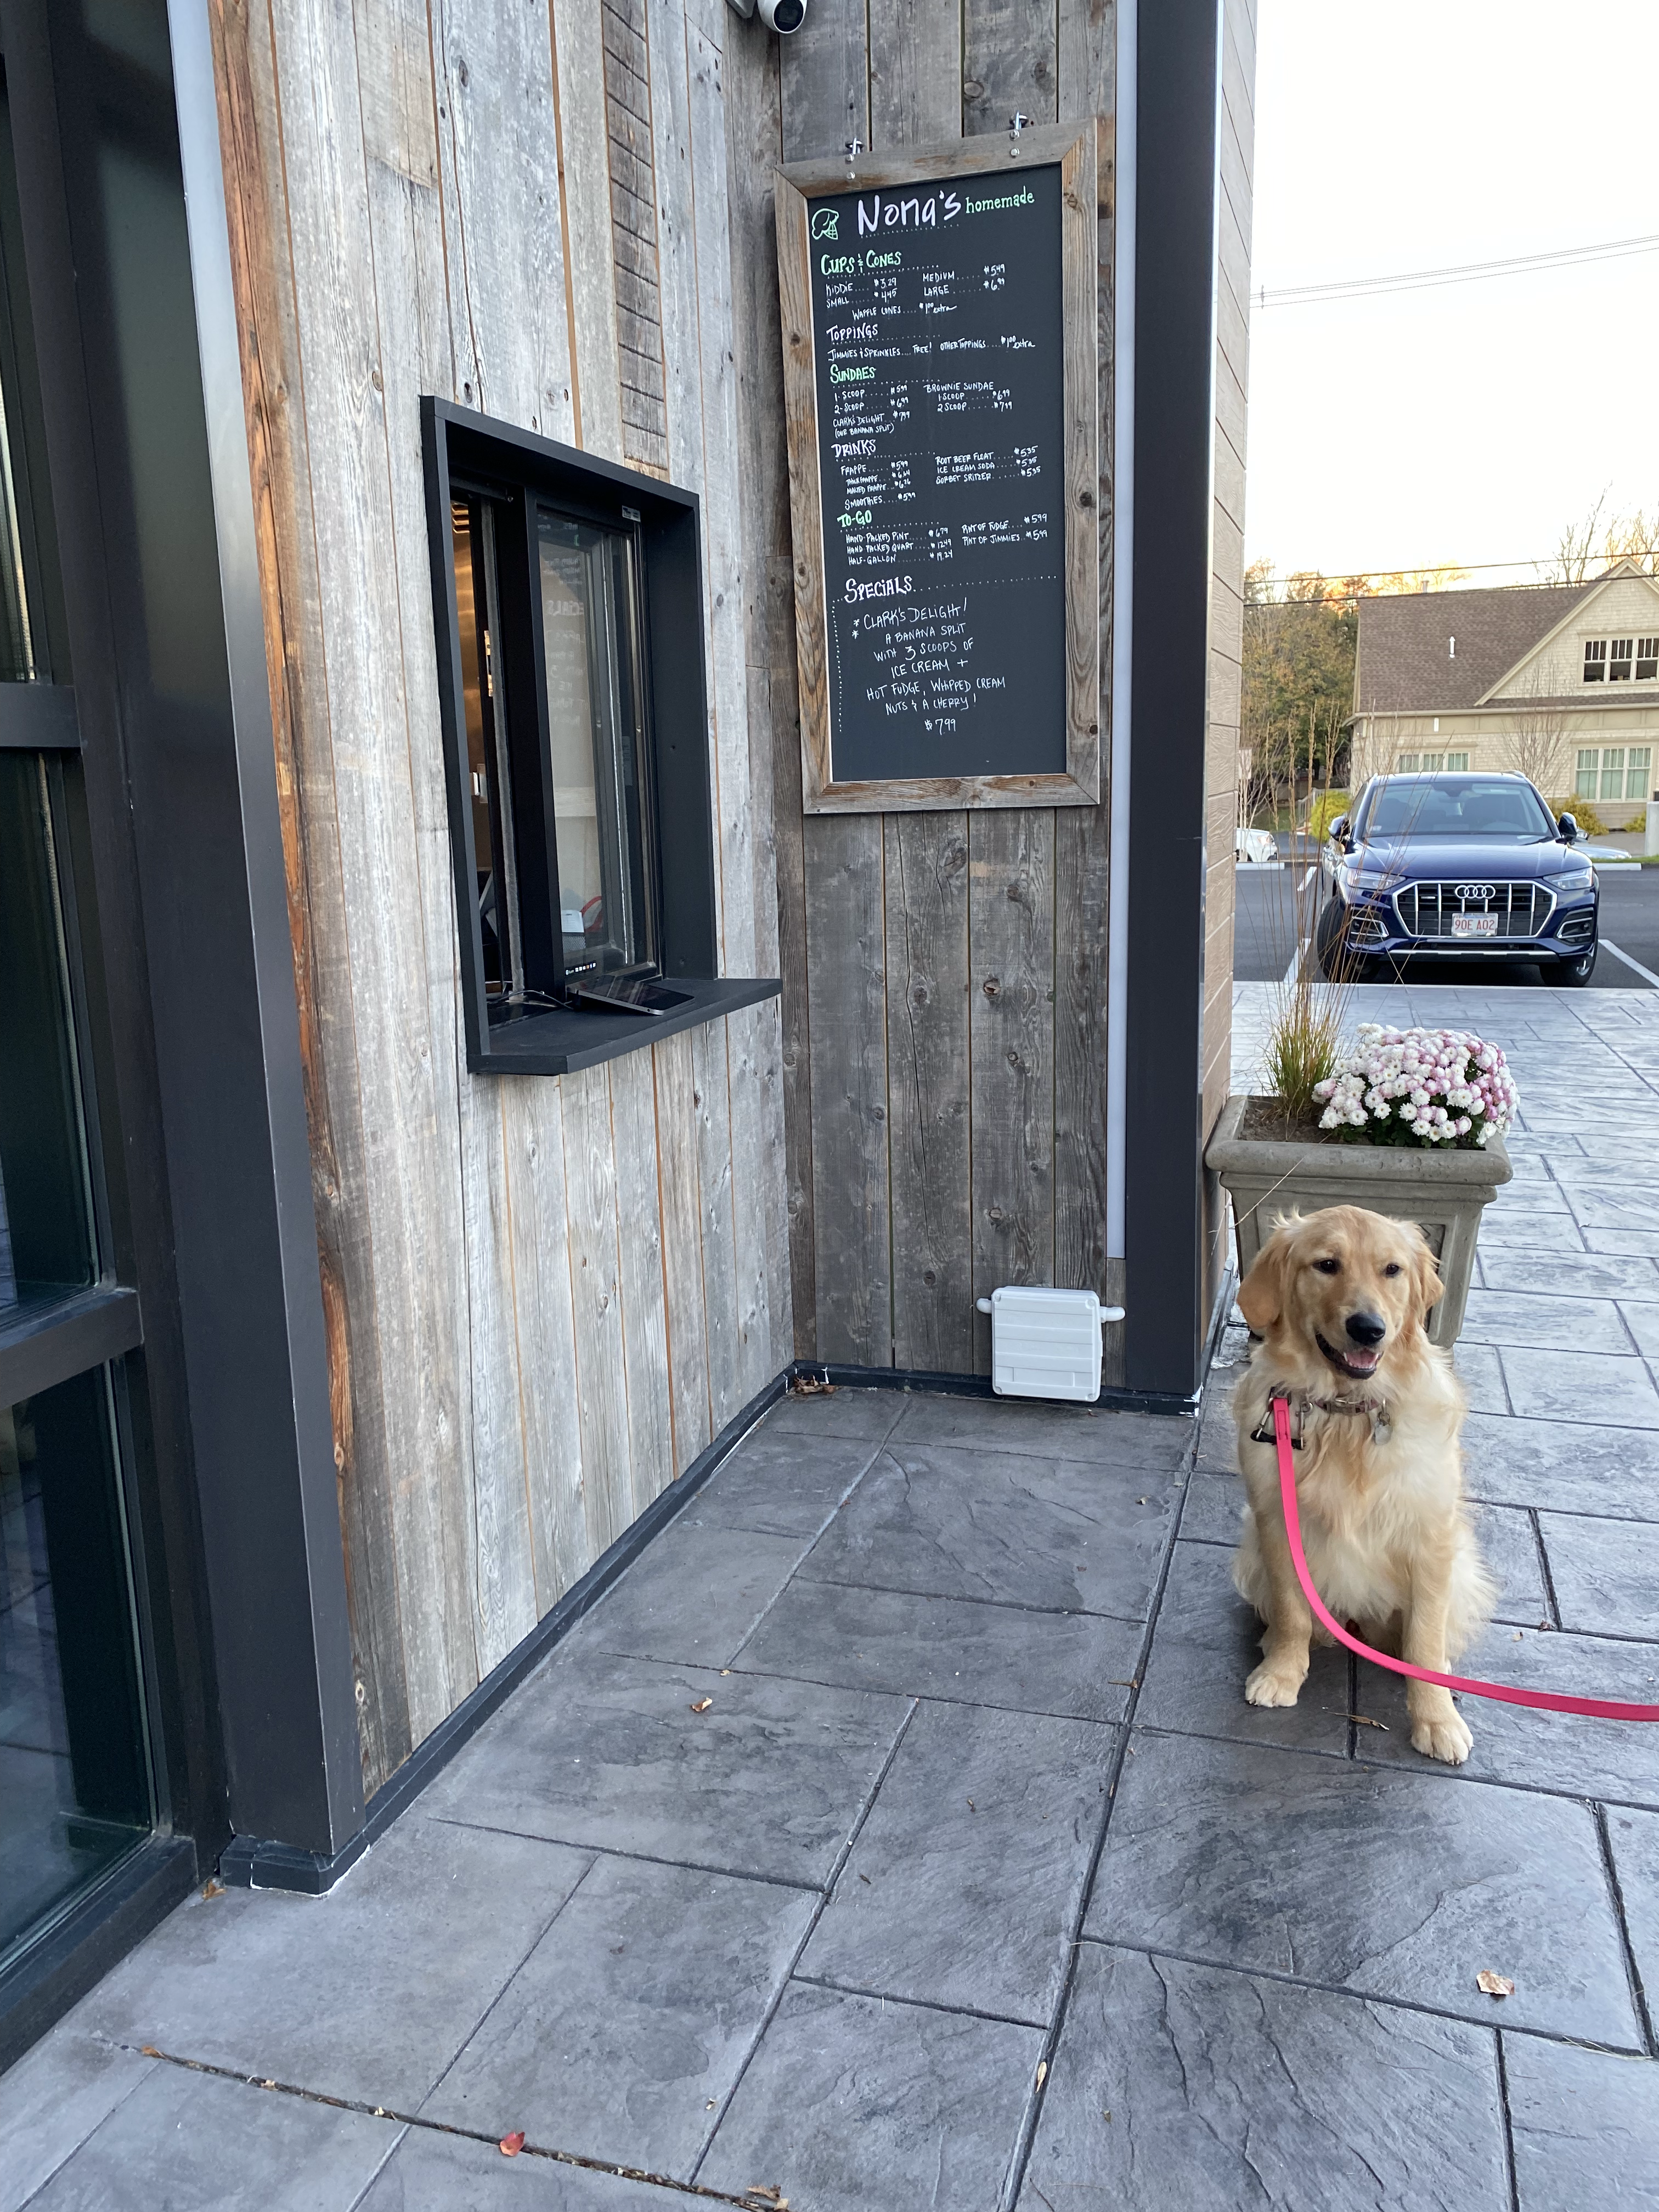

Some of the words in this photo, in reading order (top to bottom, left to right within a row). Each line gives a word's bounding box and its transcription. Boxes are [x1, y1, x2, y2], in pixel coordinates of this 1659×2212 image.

[857, 190, 961, 235] Nona's
[965, 185, 1035, 213] homemade
[821, 253, 855, 275] CUPS
[866, 250, 901, 268] CONES
[922, 270, 955, 282] MEDIUM
[924, 284, 949, 297] LARGE
[826, 296, 850, 309] SMALL
[851, 307, 877, 321] WAFFLE
[881, 306, 901, 315] CONES
[933, 303, 957, 314] extra
[826, 323, 878, 341] TOPPINGS
[864, 347, 901, 357] SPRINKLES
[912, 341, 932, 353] FREE!
[1013, 338, 1036, 349] extra
[830, 364, 876, 383] SUNDAES
[923, 382, 961, 393] BROWNIE
[963, 381, 994, 391] SUNDAE
[842, 389, 865, 400] SCOOP
[844, 402, 865, 412] SCOOP
[944, 402, 967, 411] SCOOP
[856, 413, 885, 426] DELIGHT
[849, 426, 874, 436] BANANA
[831, 439, 876, 458] DRINKS
[935, 455, 951, 465] ROOT
[953, 454, 971, 464] BEER
[973, 452, 994, 461] FLOAT
[840, 464, 866, 476] FRAPPE
[936, 466, 948, 474] ICE
[952, 463, 976, 473] CREAM
[977, 462, 995, 470] SODA
[936, 474, 961, 484] SORBET
[867, 483, 887, 492] FRAPPE
[837, 510, 872, 528] TO-GO
[977, 522, 986, 531] OF
[988, 520, 1009, 531] FUDGE
[892, 531, 909, 540] PINT
[978, 536, 988, 544] OF
[847, 545, 863, 555] HAND
[866, 543, 890, 554] PACKED
[891, 541, 914, 553] QUART
[848, 553, 896, 566] HALF-GALLON
[843, 575, 912, 603] SPECIALS
[885, 633, 891, 645] A
[894, 626, 936, 642] BANANA
[940, 623, 966, 636] SPLIT
[873, 647, 897, 662] WITH
[905, 645, 916, 661] 3
[919, 641, 957, 654] SCOOPS
[963, 637, 974, 651] OF
[890, 664, 907, 679] ICE
[911, 658, 950, 673] CREAM
[866, 685, 888, 701] HOT
[930, 678, 971, 692] WHIPPED
[976, 676, 1006, 690] CREAM
[885, 701, 908, 715] NUTS
[922, 699, 929, 710] A
[1454, 919, 1474, 930] 90E
[1476, 919, 1495, 930] A02
